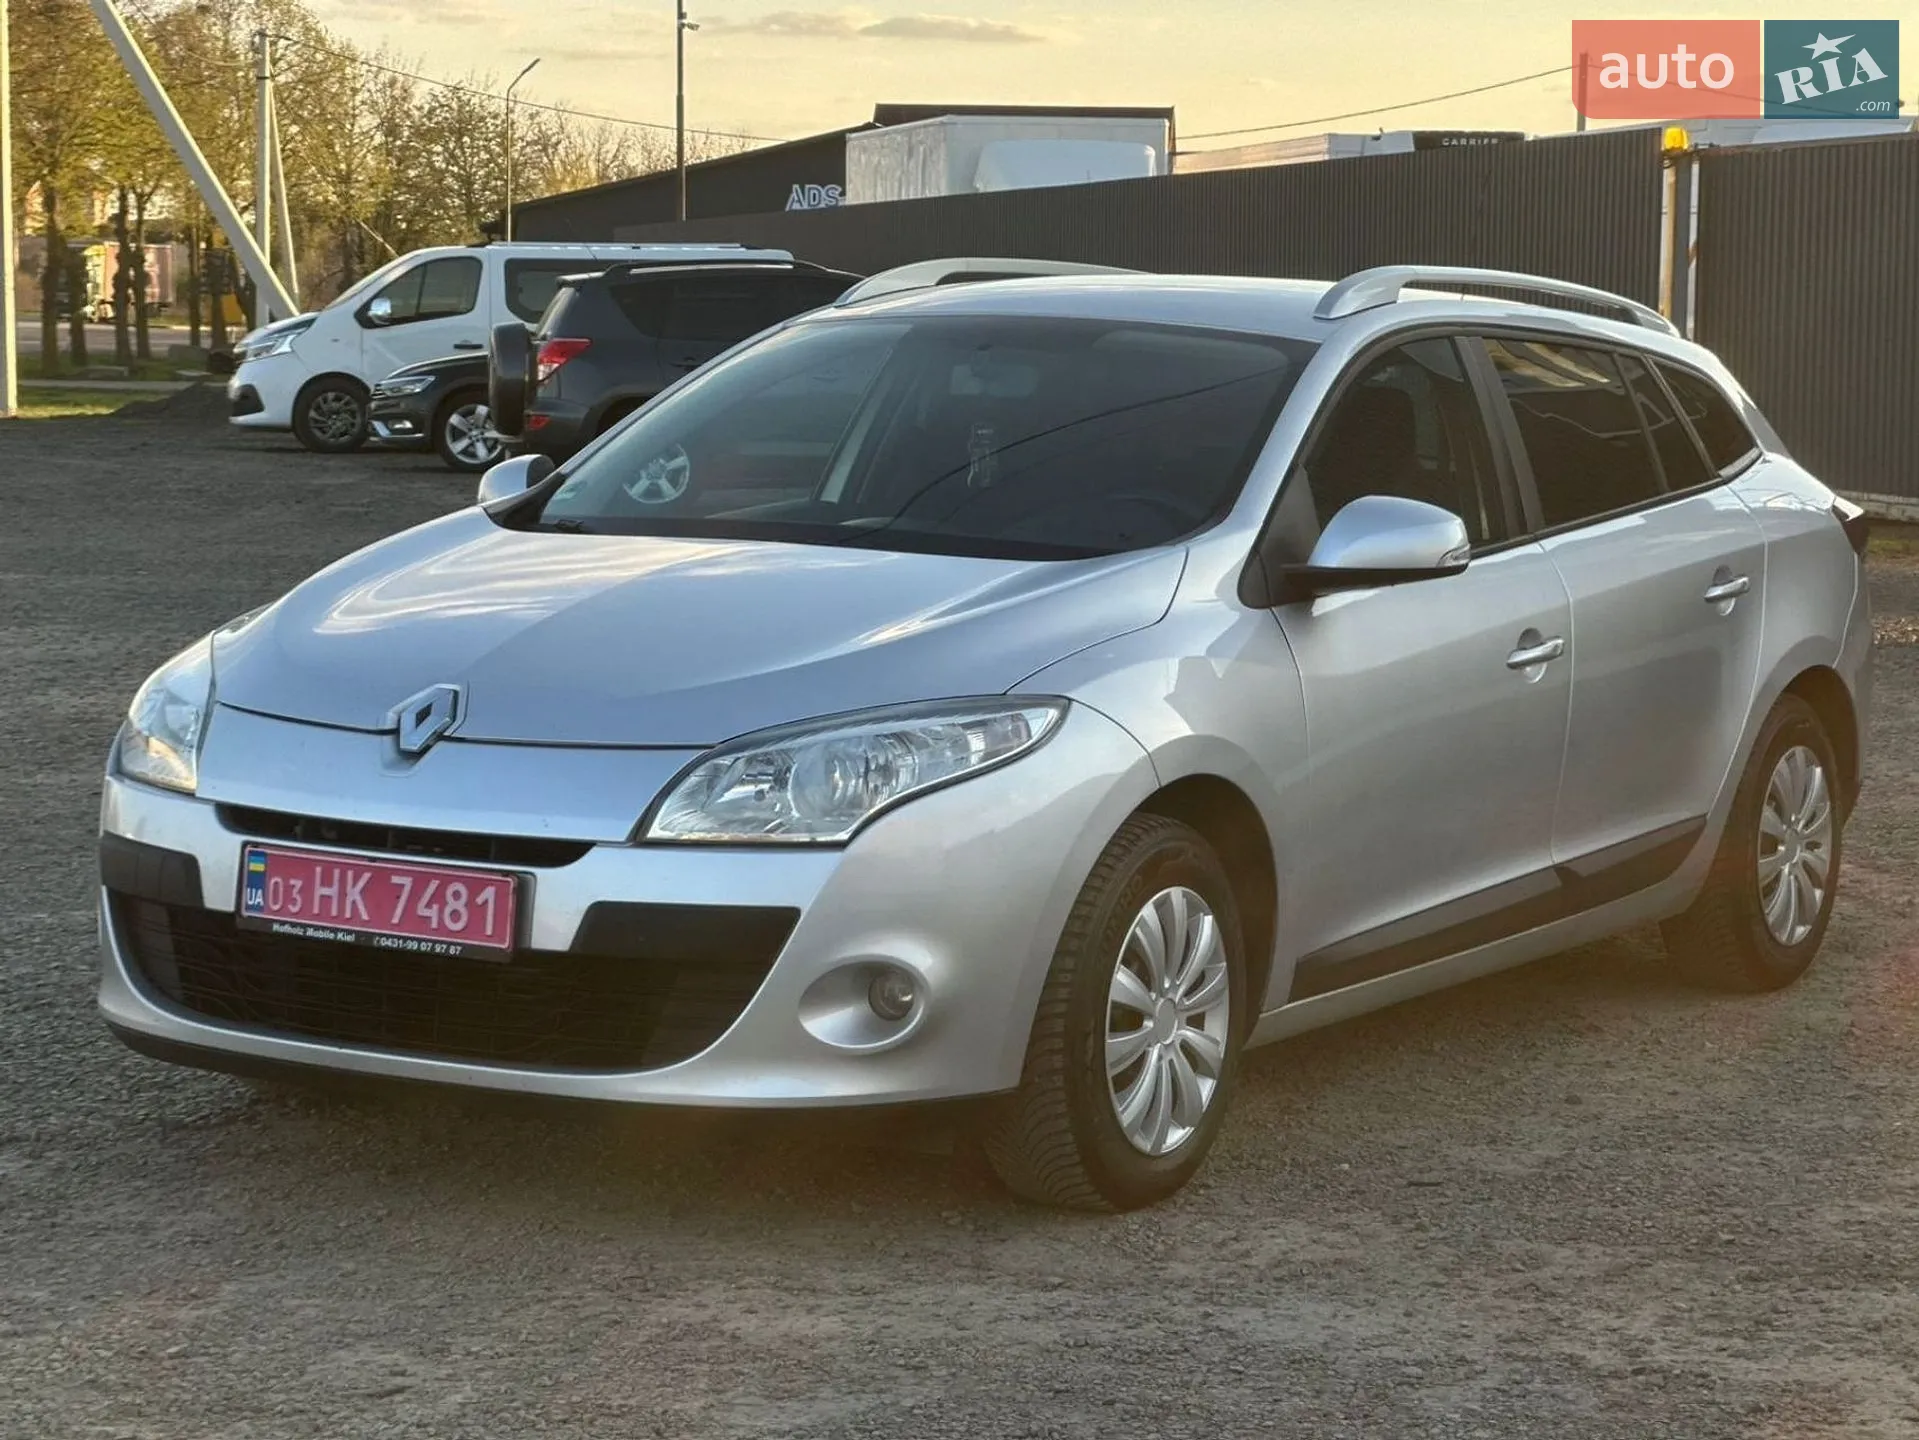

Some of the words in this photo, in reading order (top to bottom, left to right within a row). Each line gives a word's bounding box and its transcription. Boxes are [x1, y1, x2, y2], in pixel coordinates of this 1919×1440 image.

[247, 888, 264, 907] UA
[269, 876, 303, 914] 03
[312, 866, 372, 921] HK
[390, 875, 497, 937] 7481
[306, 927, 335, 939] Mobile
